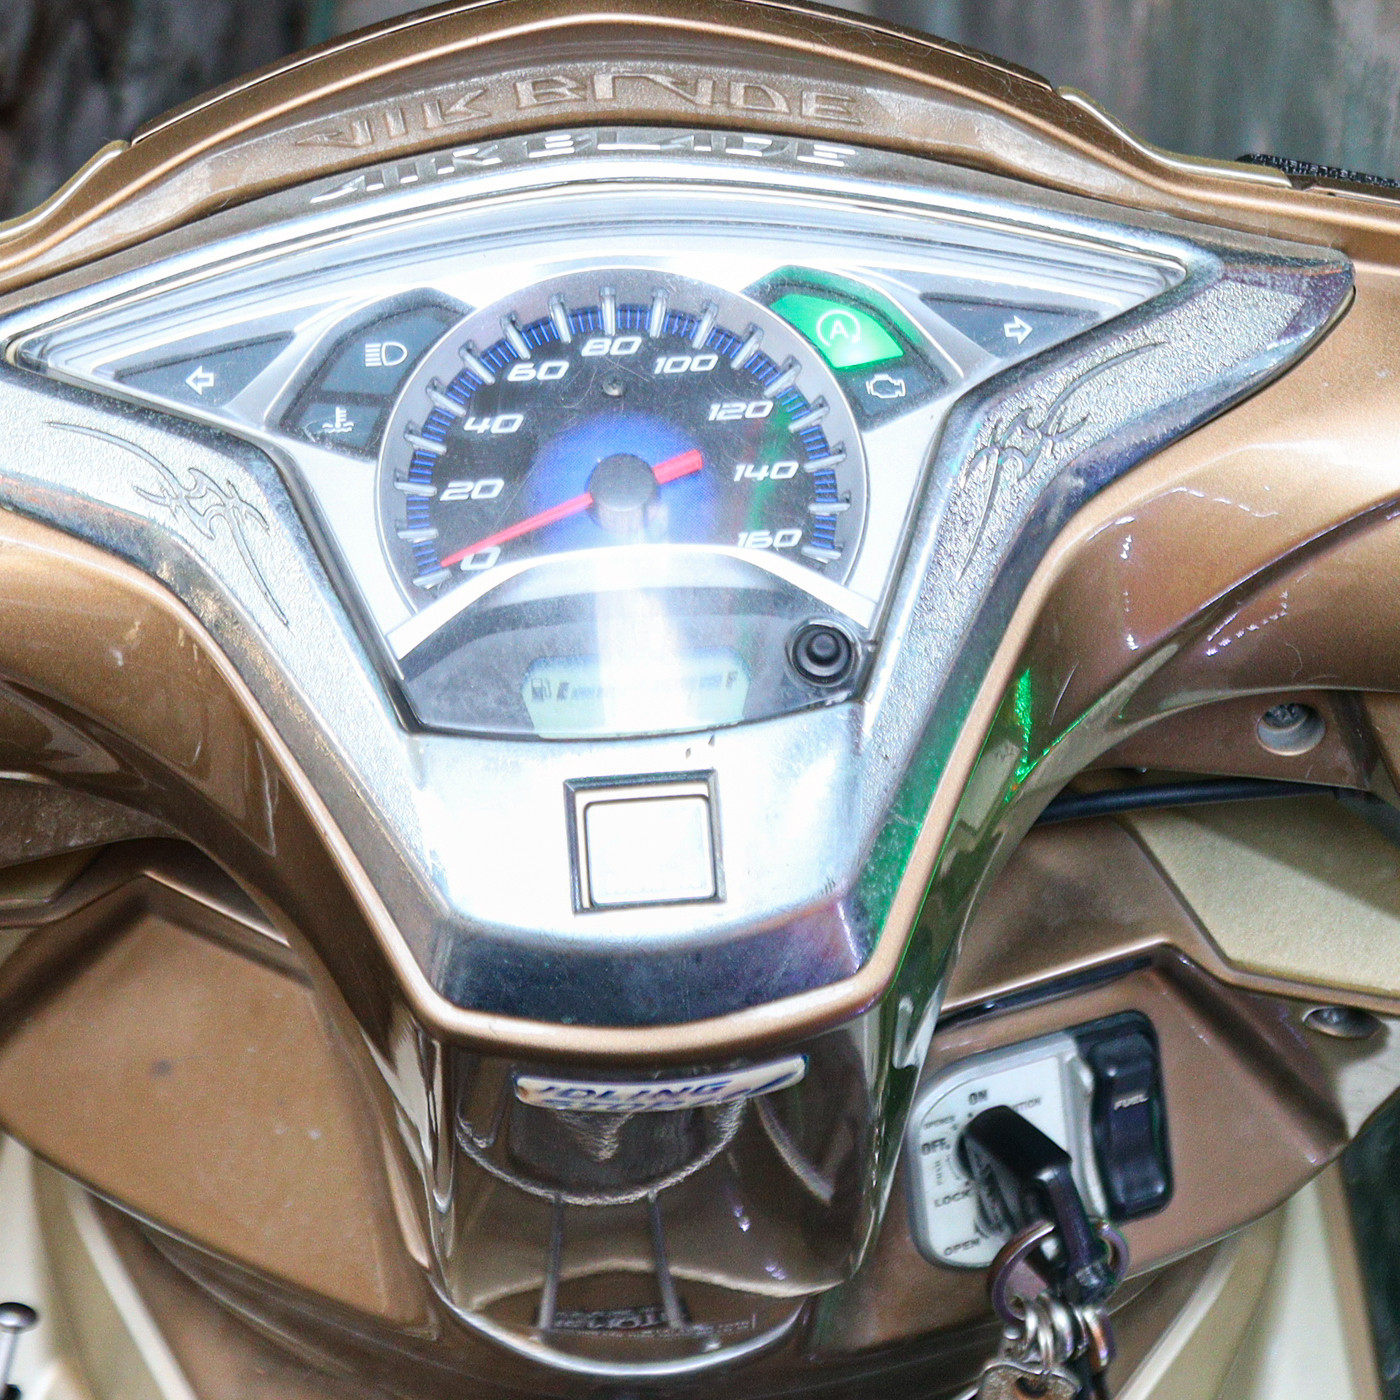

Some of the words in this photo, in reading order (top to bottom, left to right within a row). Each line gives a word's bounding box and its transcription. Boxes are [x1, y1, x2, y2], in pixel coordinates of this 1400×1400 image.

[580, 336, 642, 357] 80
[506, 360, 570, 382] 60
[653, 353, 719, 375] 100
[707, 400, 774, 421] 120
[463, 413, 524, 435] 40
[733, 460, 800, 482] 140
[440, 478, 505, 500] 20
[737, 529, 802, 550] 160
[459, 545, 501, 572] 0
[968, 1089, 988, 1106] ON
[1114, 1094, 1150, 1111] FUEL
[921, 1137, 947, 1156] OFF
[933, 1188, 972, 1208] LOCK
[944, 1236, 981, 1257] OPEN
